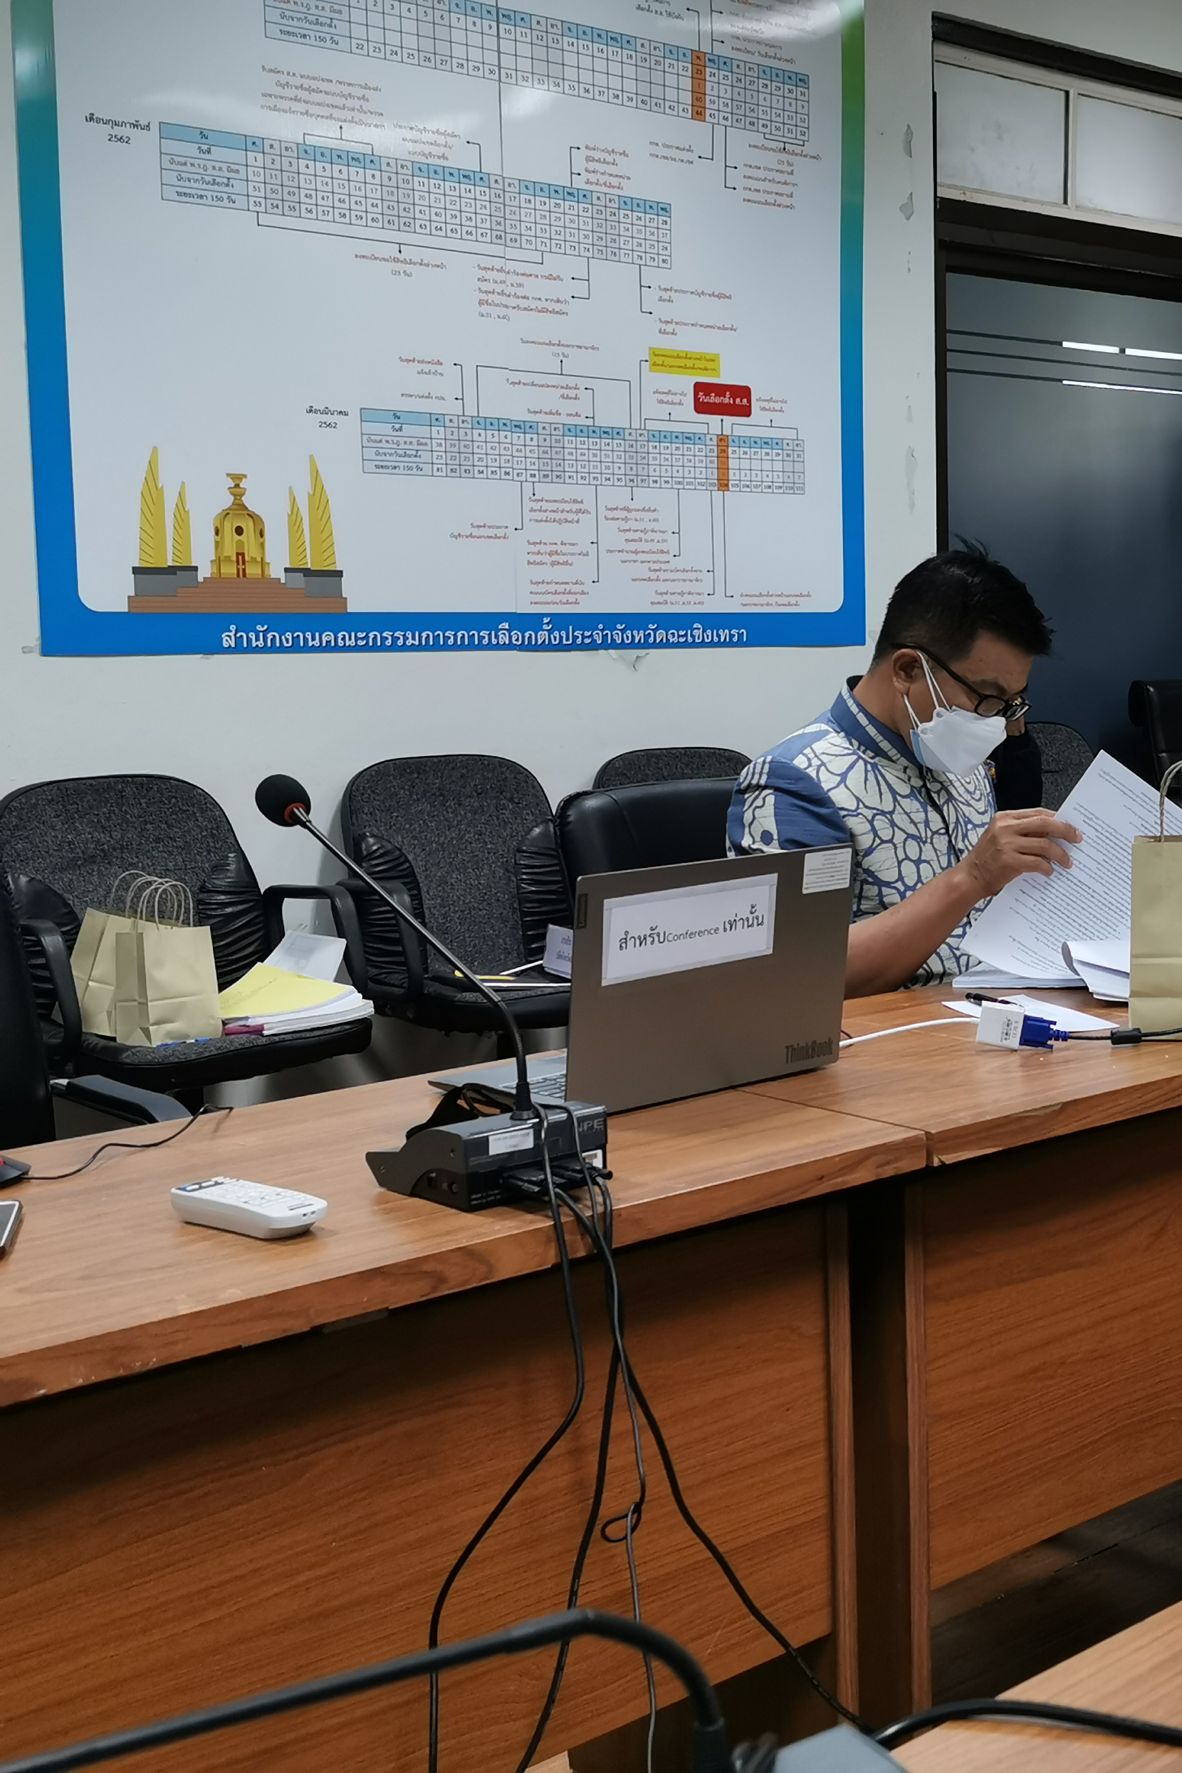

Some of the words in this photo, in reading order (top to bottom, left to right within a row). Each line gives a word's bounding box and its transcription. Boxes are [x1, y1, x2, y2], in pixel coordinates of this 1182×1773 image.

[314, 35, 327, 44] 150
[85, 112, 151, 132] เดือนกุมภาพันธ์
[107, 133, 131, 145] 2562
[211, 193, 224, 202] 150
[306, 406, 349, 417] เดือนมีนาคม
[318, 421, 338, 430] 2562
[723, 903, 765, 933] เท่านั้น
